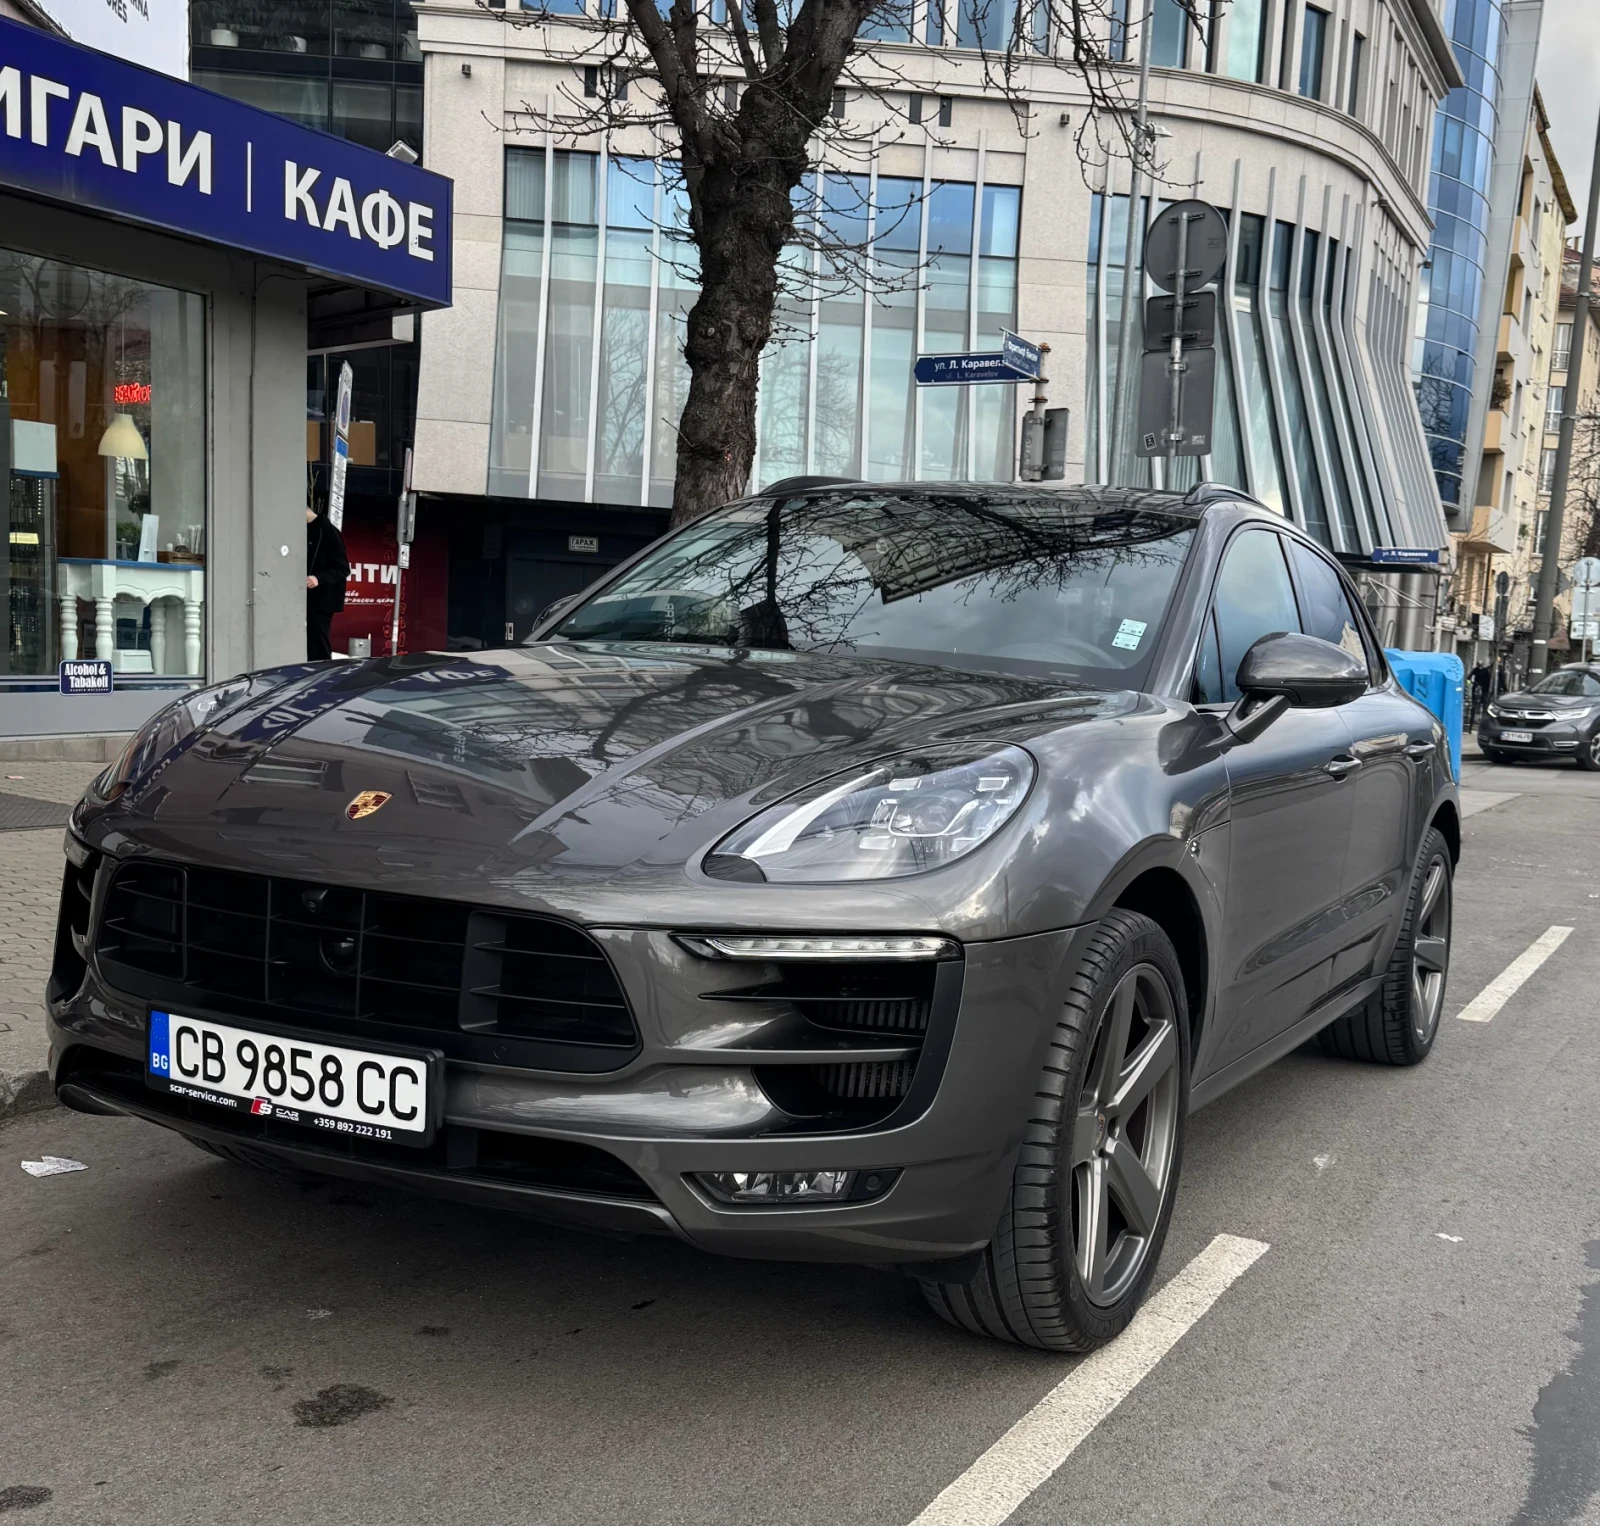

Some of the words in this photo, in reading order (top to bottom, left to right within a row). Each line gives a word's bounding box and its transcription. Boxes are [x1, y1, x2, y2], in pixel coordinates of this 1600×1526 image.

[285, 160, 433, 261] КАФЕ
[934, 361, 946, 371] ул.
[949, 360, 958, 369] Л.
[964, 370, 999, 378] Karavelov
[64, 663, 98, 676] Alcohol
[98, 662, 107, 675] &
[152, 1052, 169, 1070] BG
[176, 1025, 227, 1084] CB
[236, 1039, 345, 1108] 9858
[357, 1060, 419, 1121] CC
[169, 1083, 238, 1108] scar-service.com
[313, 1117, 336, 1129] +359
[336, 1121, 354, 1132] 892
[355, 1124, 373, 1136] 222
[375, 1127, 392, 1139] 191
